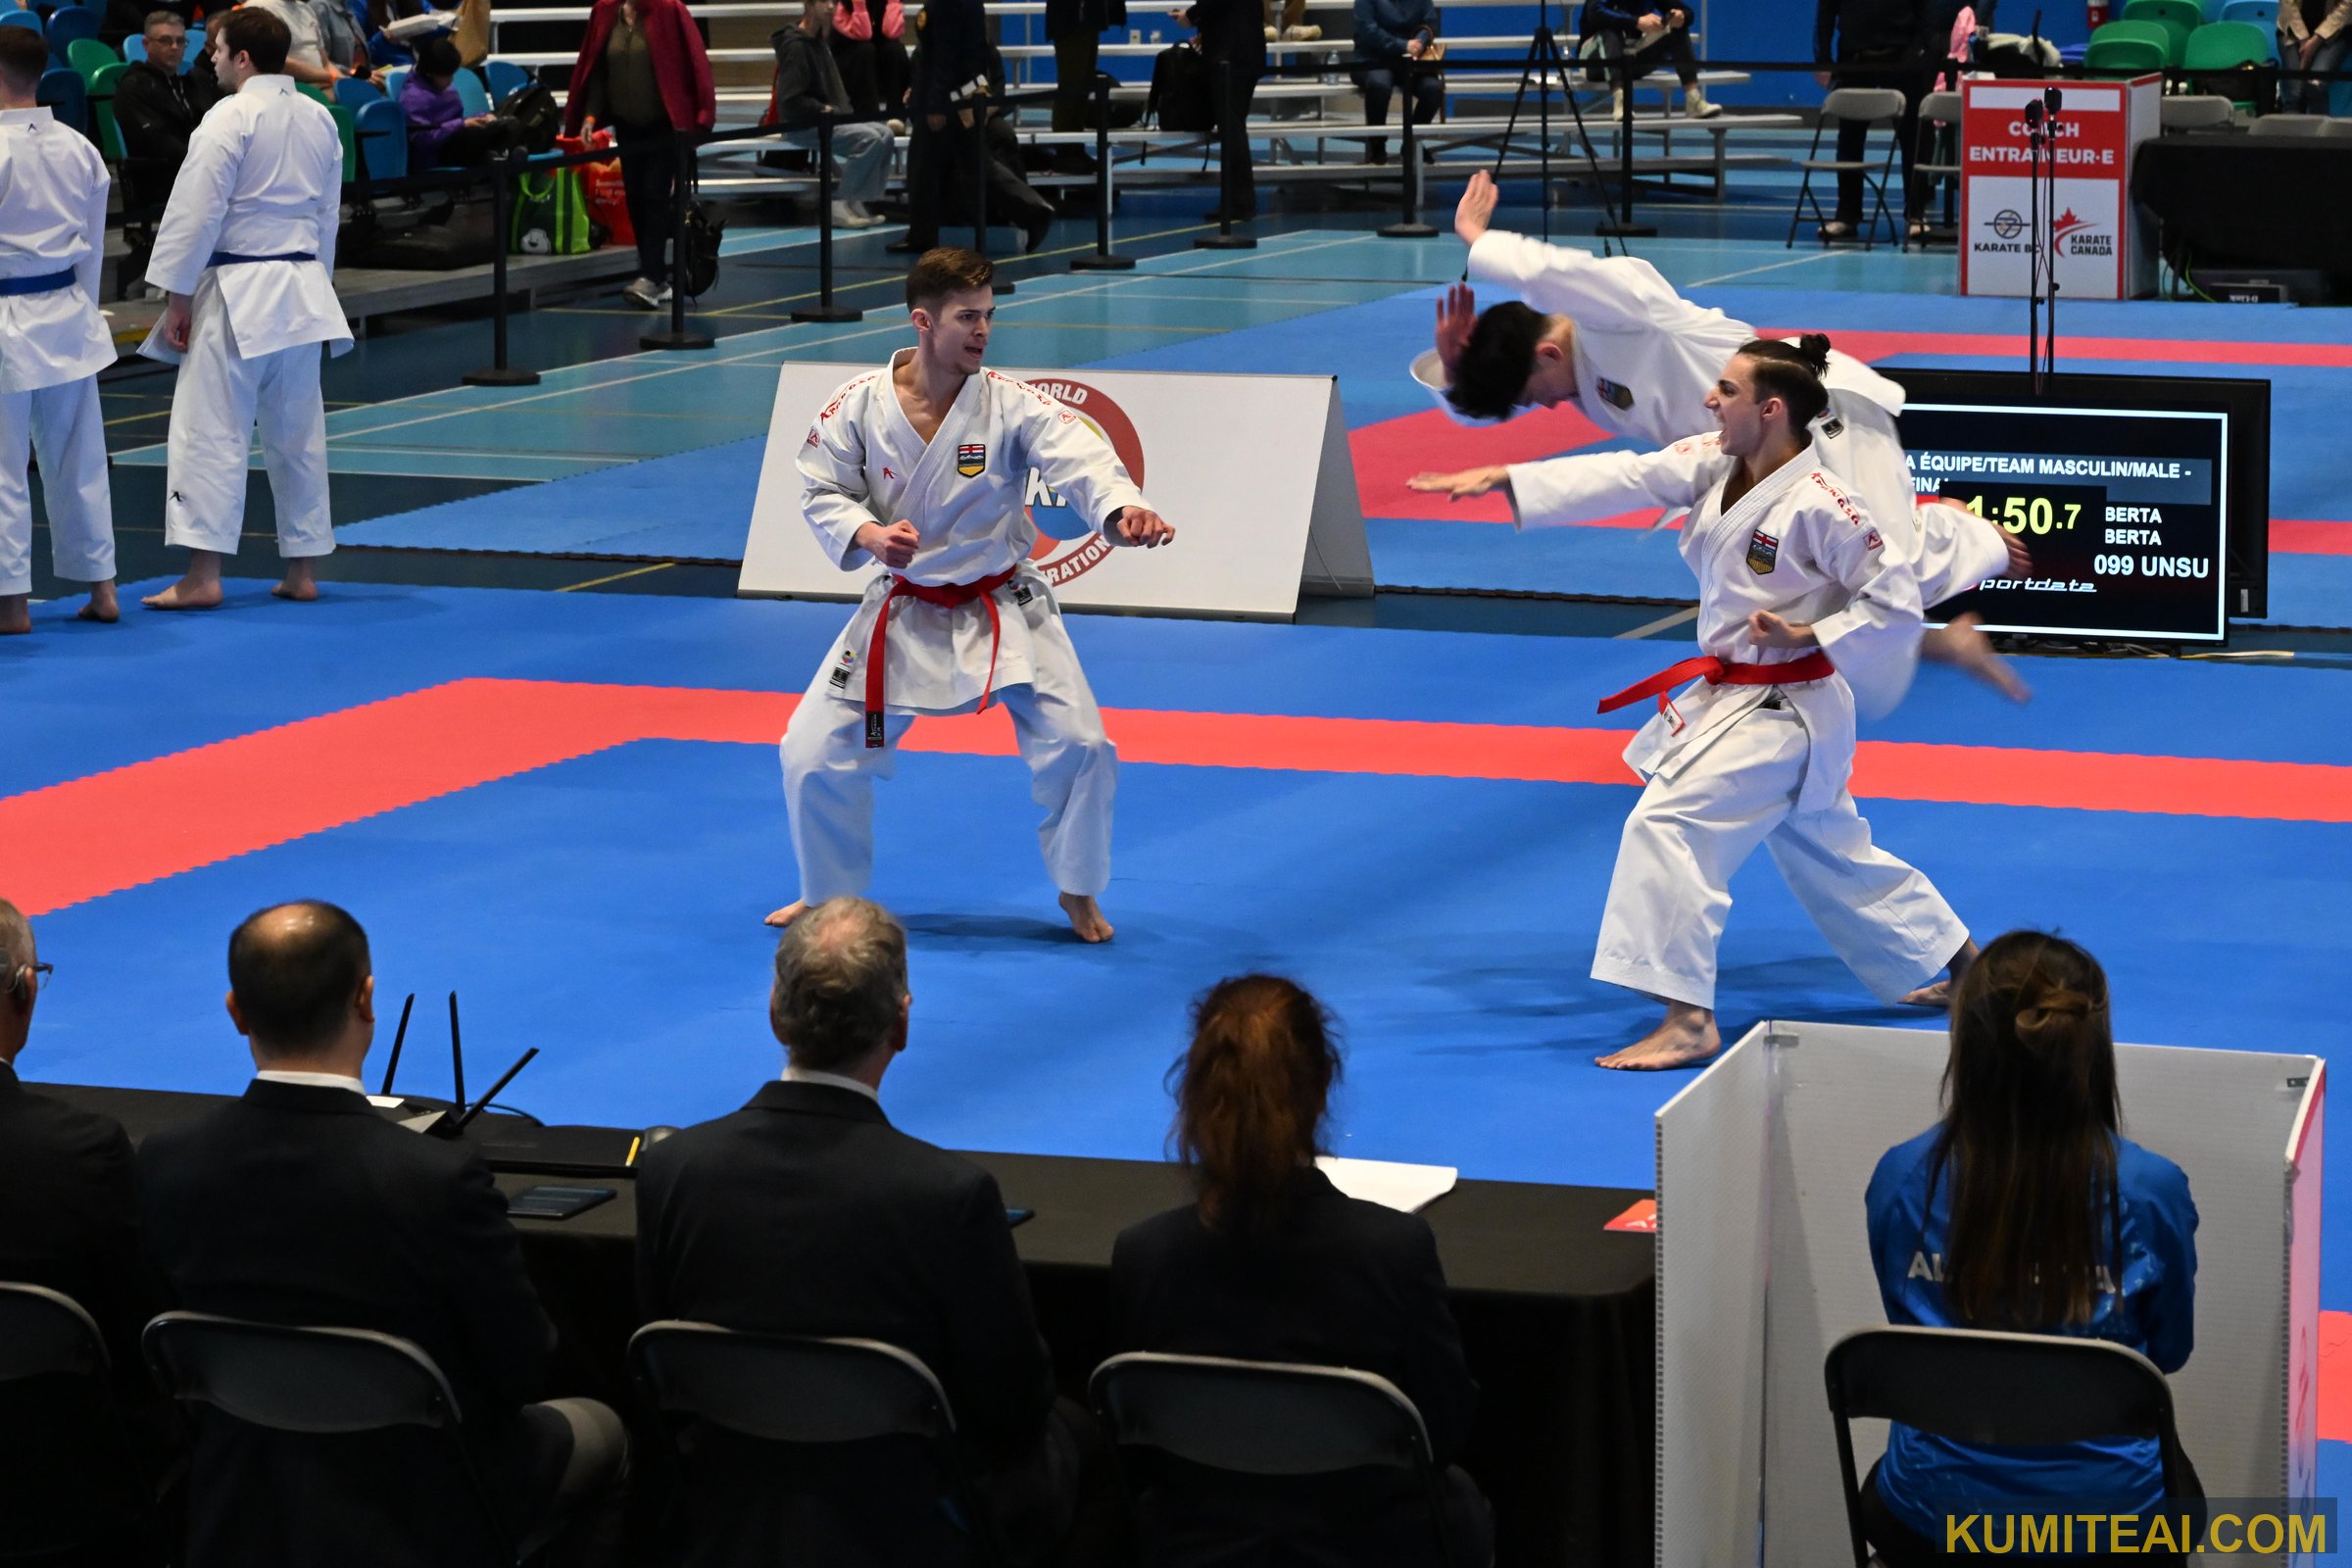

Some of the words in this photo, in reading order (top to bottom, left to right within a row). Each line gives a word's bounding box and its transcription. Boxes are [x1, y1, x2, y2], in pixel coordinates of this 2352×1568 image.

[1974, 242, 2021, 253] KARATE
[2071, 234, 2112, 245] KARATE
[2070, 245, 2113, 256] CANADA
[1032, 382, 1088, 405] ORLD
[1920, 451, 2034, 474] ÉQUIPE/TEAM
[2038, 459, 2180, 479] MASCULIN/MALE
[2105, 506, 2162, 523] BERTA
[2104, 528, 2162, 546] BERTA
[1046, 534, 1111, 584] RATION
[2093, 554, 2134, 576] 099
[2141, 556, 2209, 579] UNSU
[1970, 577, 2097, 593] portdata
